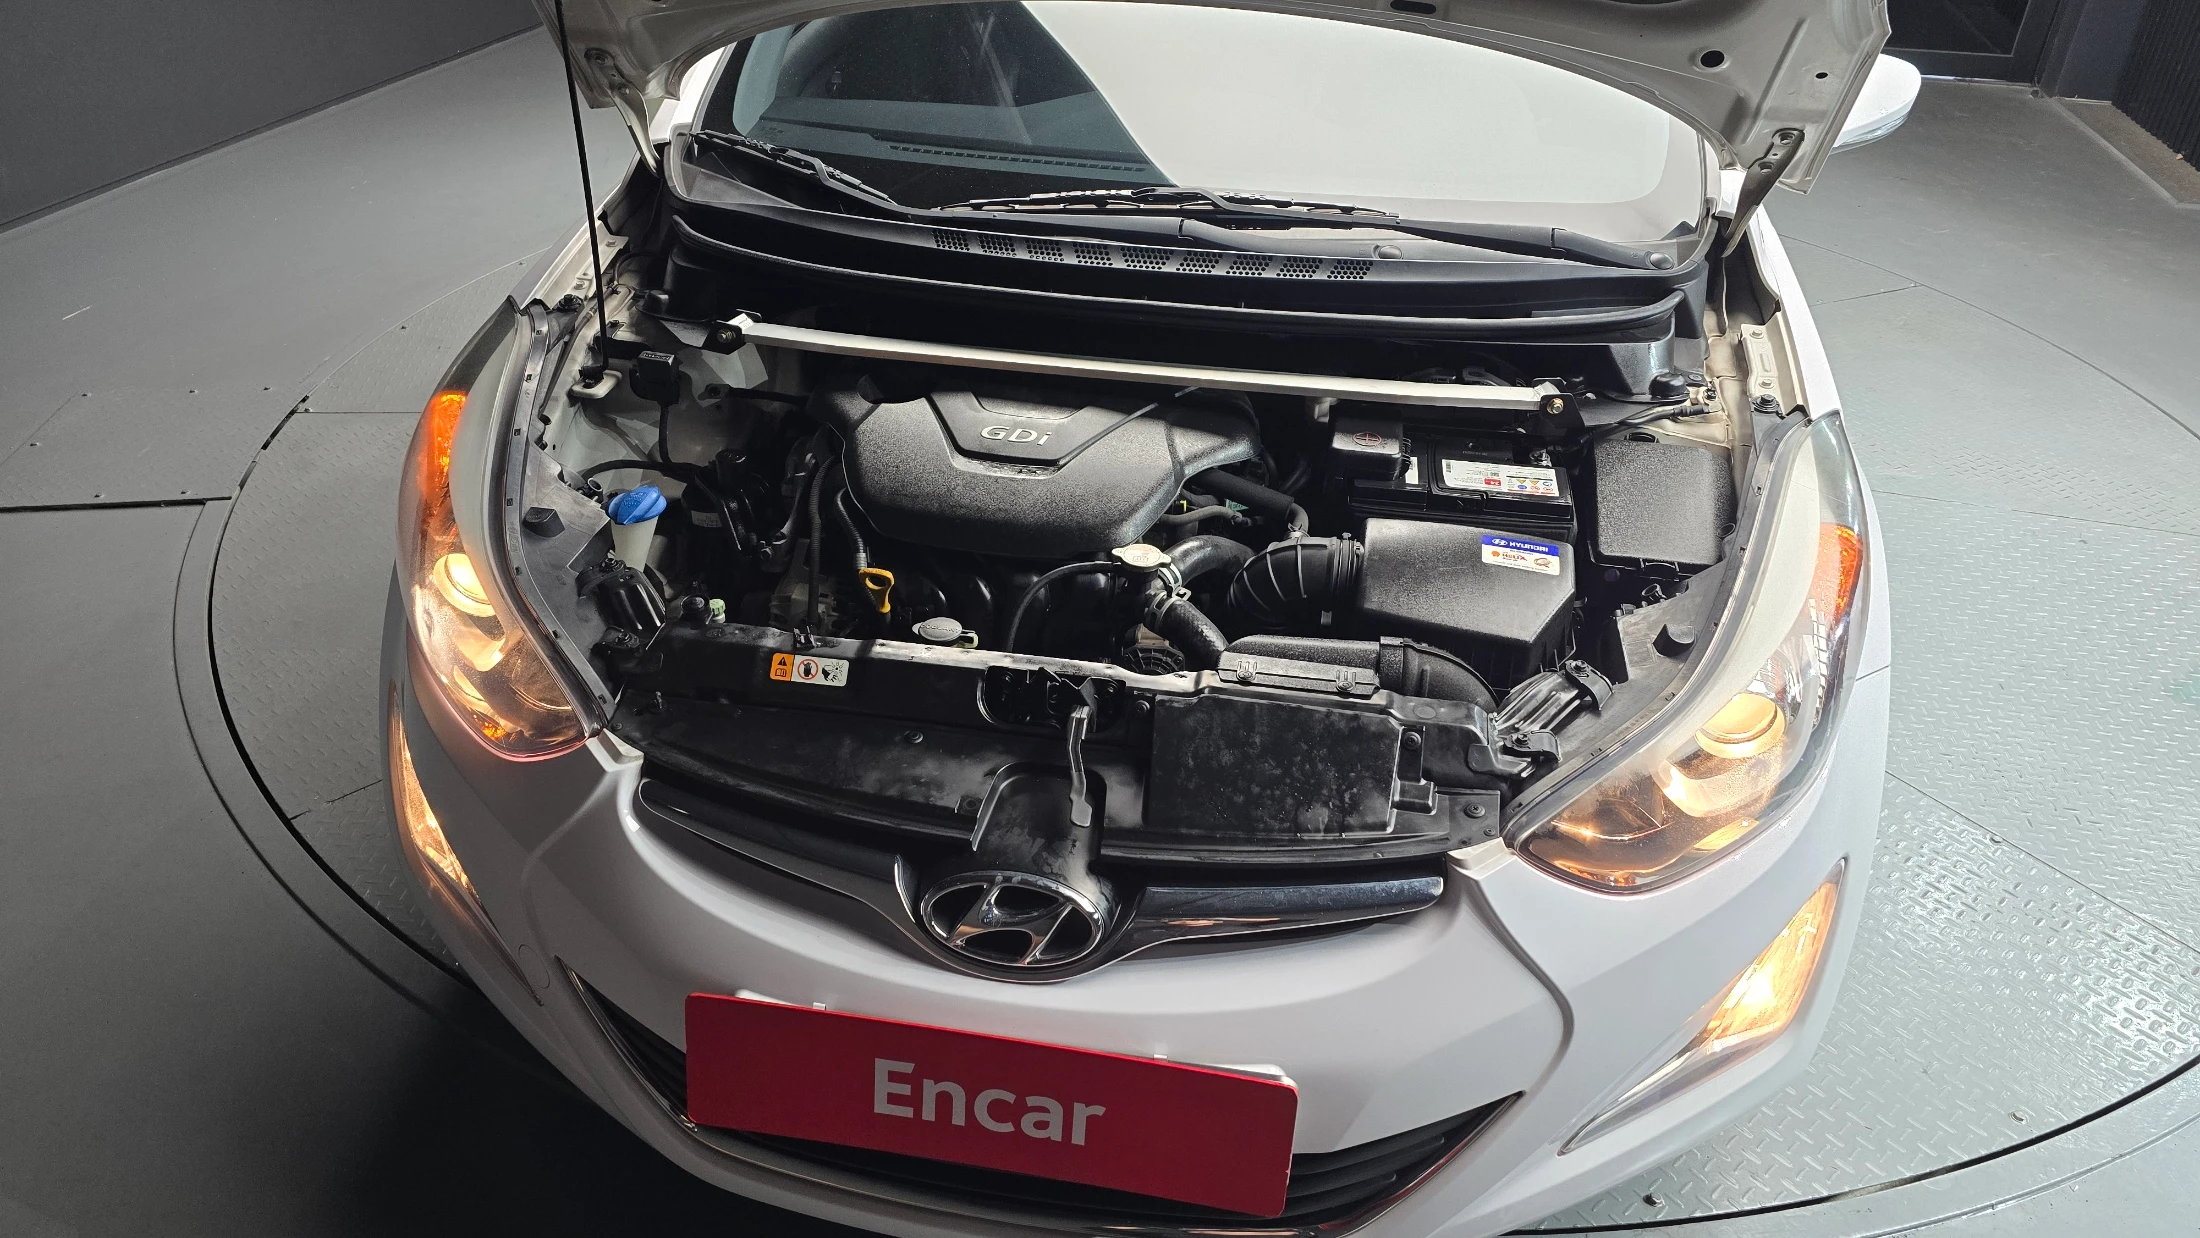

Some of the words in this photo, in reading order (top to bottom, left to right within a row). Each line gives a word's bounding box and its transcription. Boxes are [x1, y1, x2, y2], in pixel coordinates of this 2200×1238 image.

[980, 425, 1052, 446] GDi
[1509, 541, 1549, 552] HYUNDAI
[874, 1058, 1106, 1146] Encar
